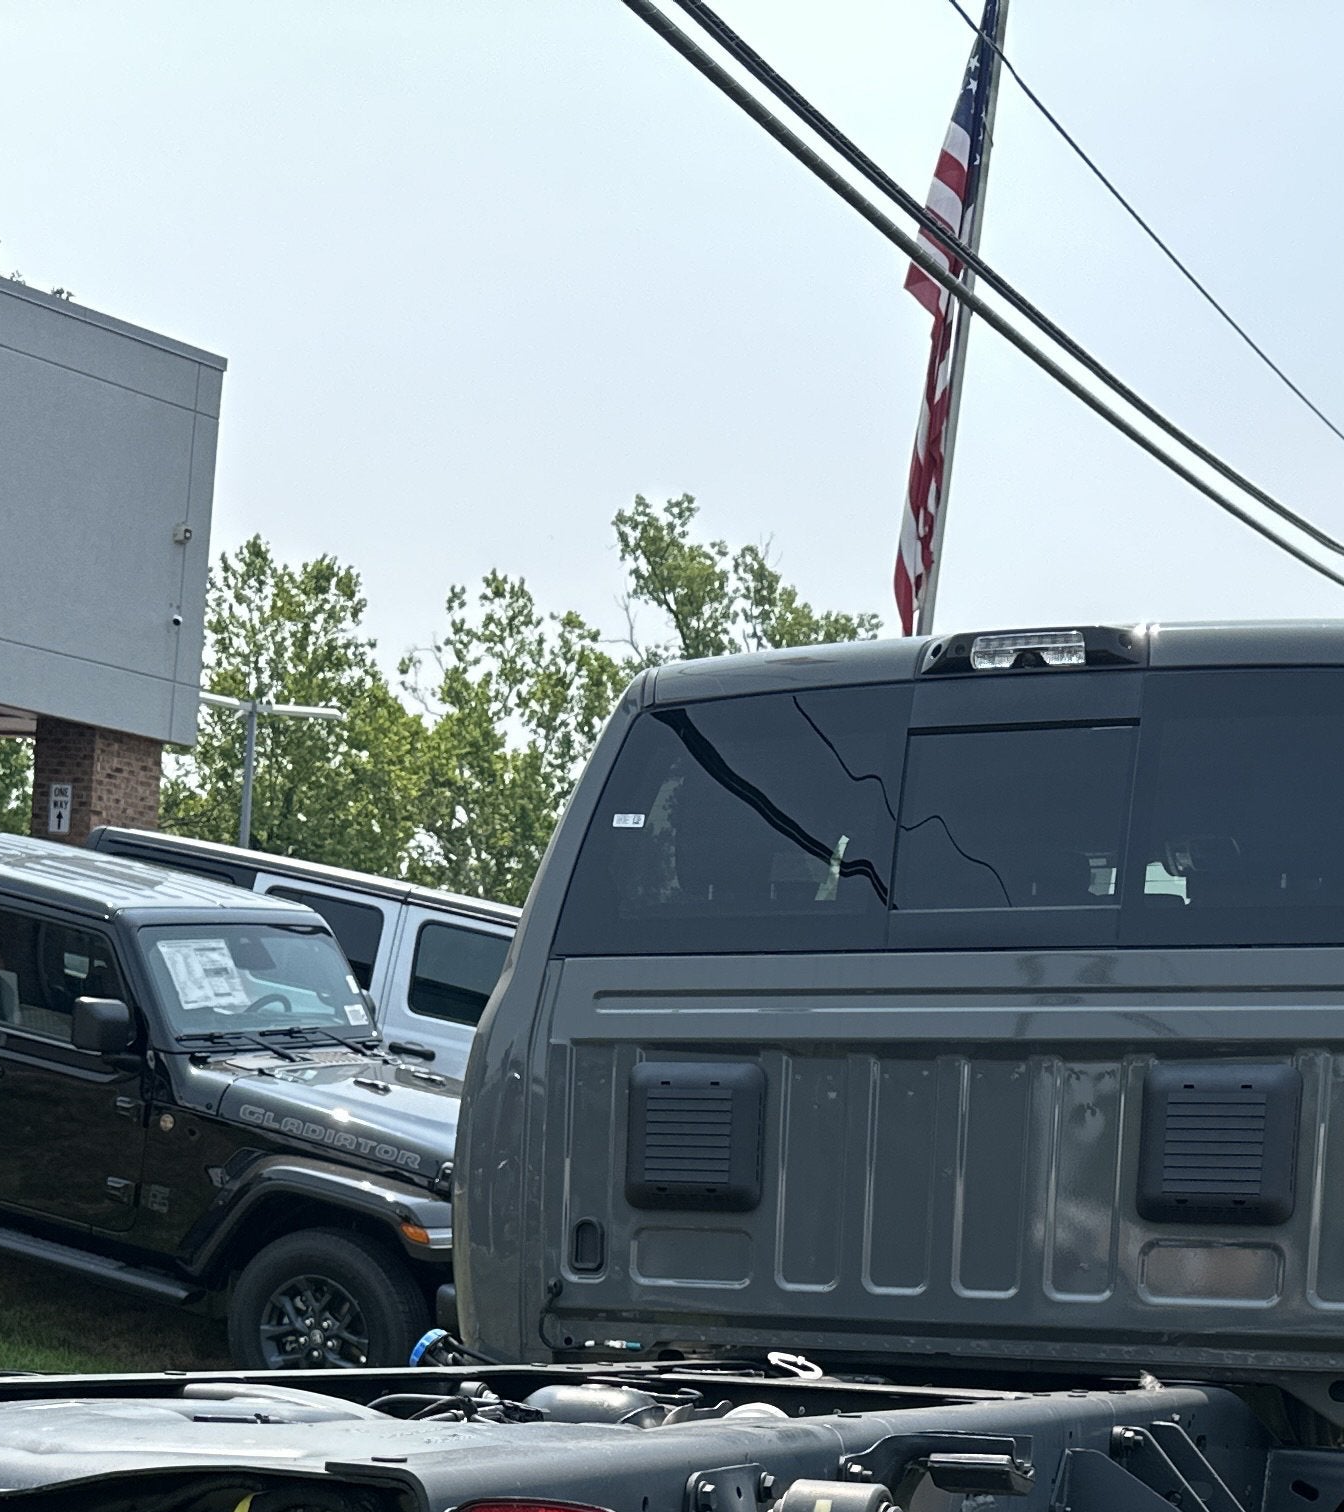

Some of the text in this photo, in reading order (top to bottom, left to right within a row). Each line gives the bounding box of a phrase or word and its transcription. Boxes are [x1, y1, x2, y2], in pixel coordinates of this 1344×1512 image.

[54, 786, 69, 798] ONE
[53, 799, 69, 810] WAY
[239, 1103, 421, 1169] GLADIATOR
